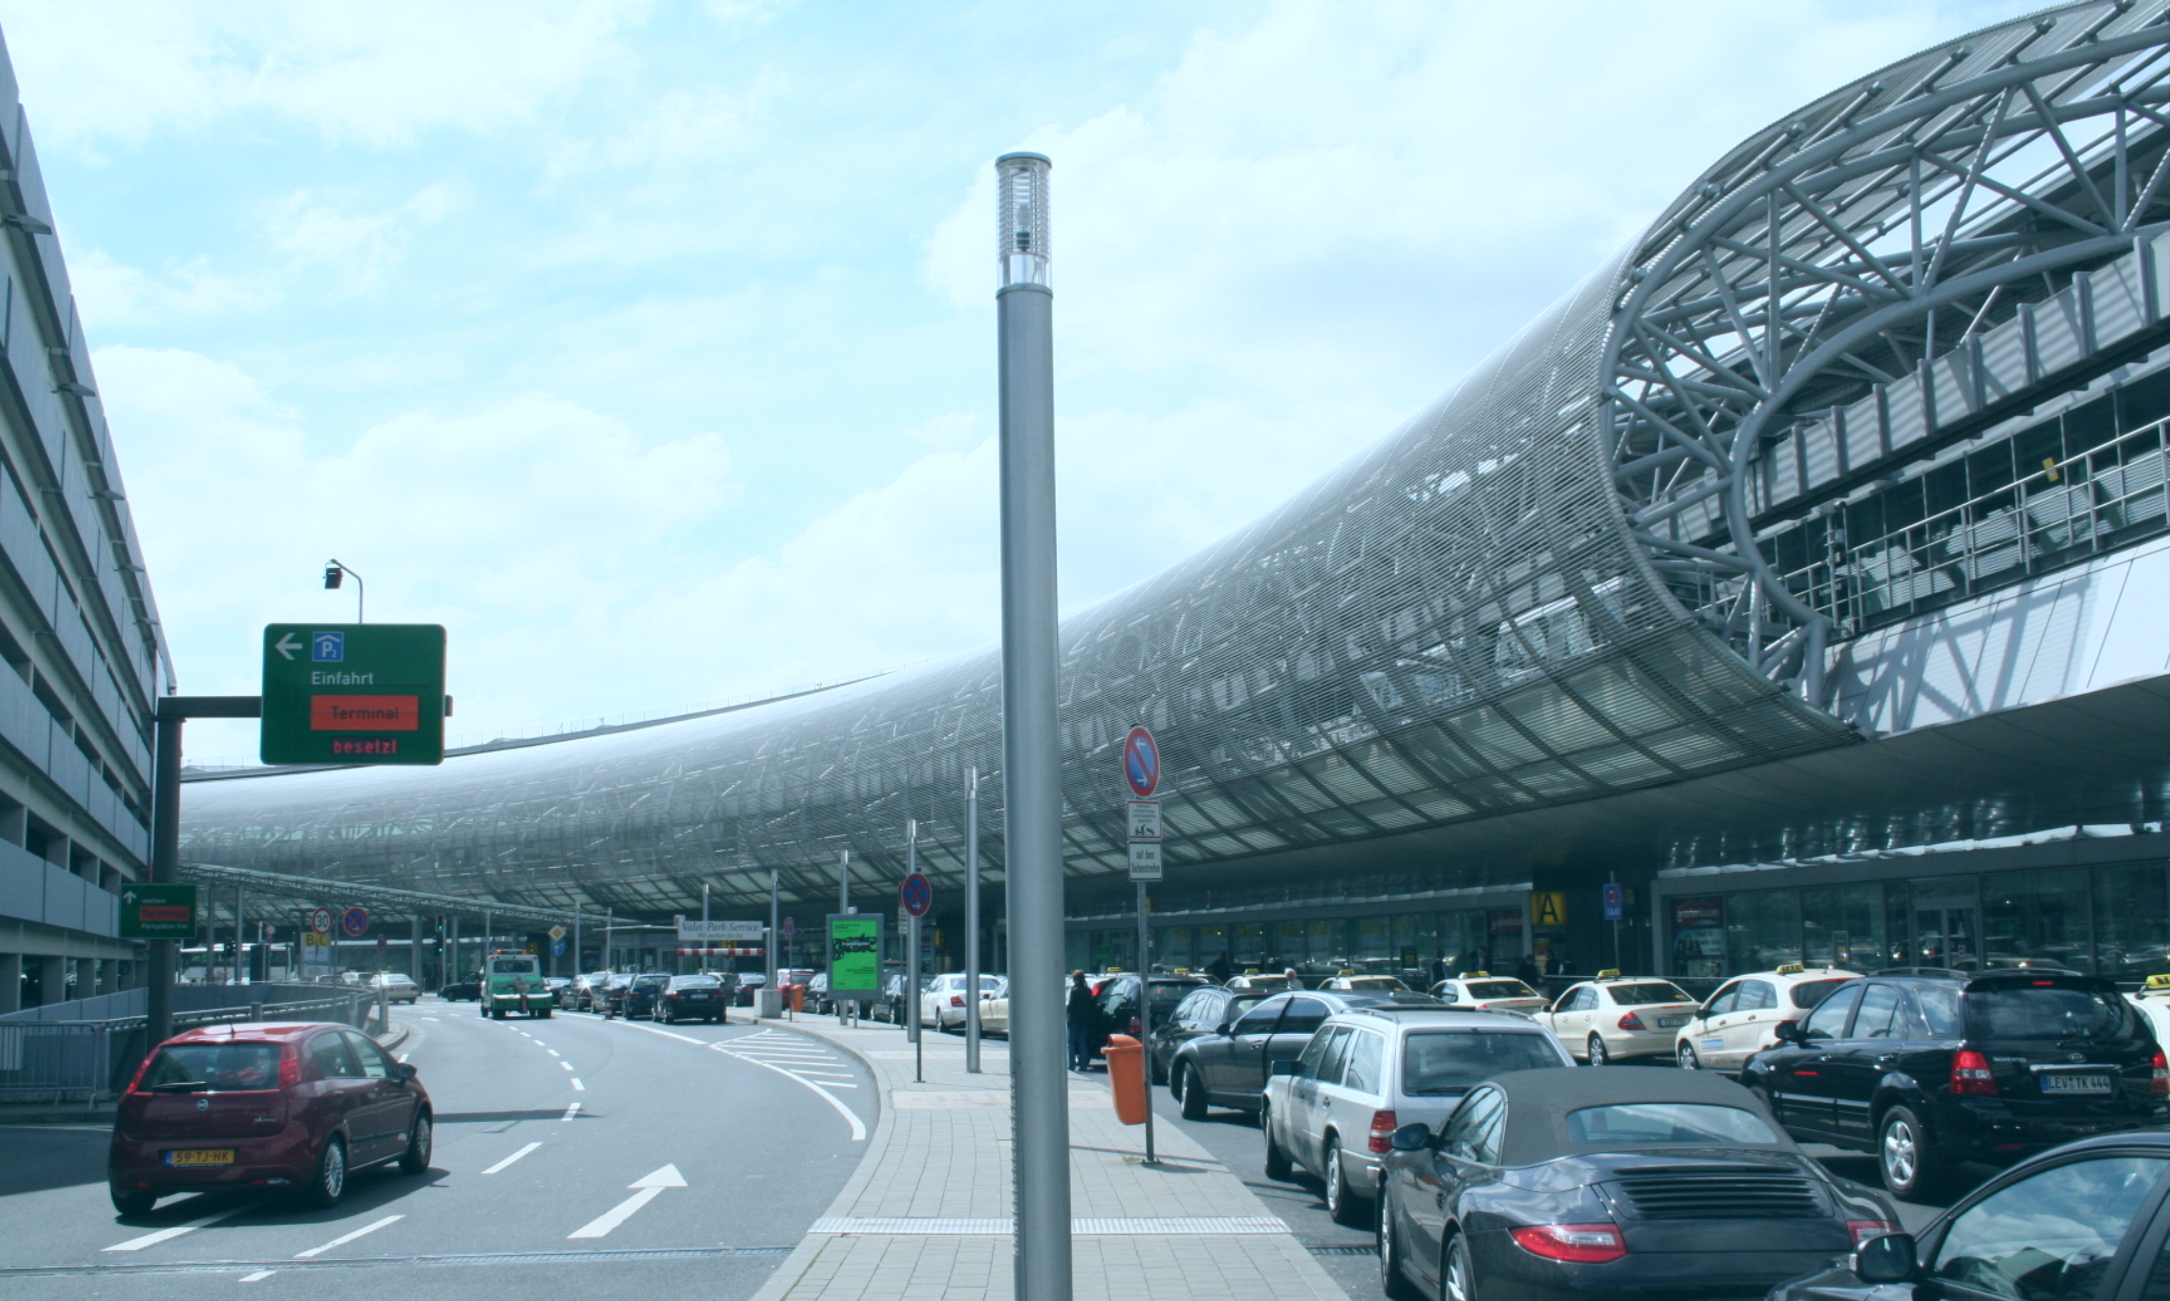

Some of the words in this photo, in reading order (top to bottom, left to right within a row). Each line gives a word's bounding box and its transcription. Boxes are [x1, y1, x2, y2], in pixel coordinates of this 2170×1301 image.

[311, 671, 374, 685] Einfahrt
[330, 705, 399, 720] Terminal
[333, 739, 398, 754] besetzt
[142, 907, 188, 918] Terminal
[1540, 893, 1559, 923] A
[1607, 908, 1621, 916] TAXI
[316, 915, 329, 928] 30
[683, 921, 760, 932] Valet-Park-Service
[306, 934, 314, 946] B
[1782, 964, 1801, 972] TAXI
[2049, 1077, 2069, 1089] LEV
[2075, 1077, 2089, 1089] TK
[2091, 1076, 2110, 1089] 444
[175, 1151, 229, 1163] 59-TJ-HK
